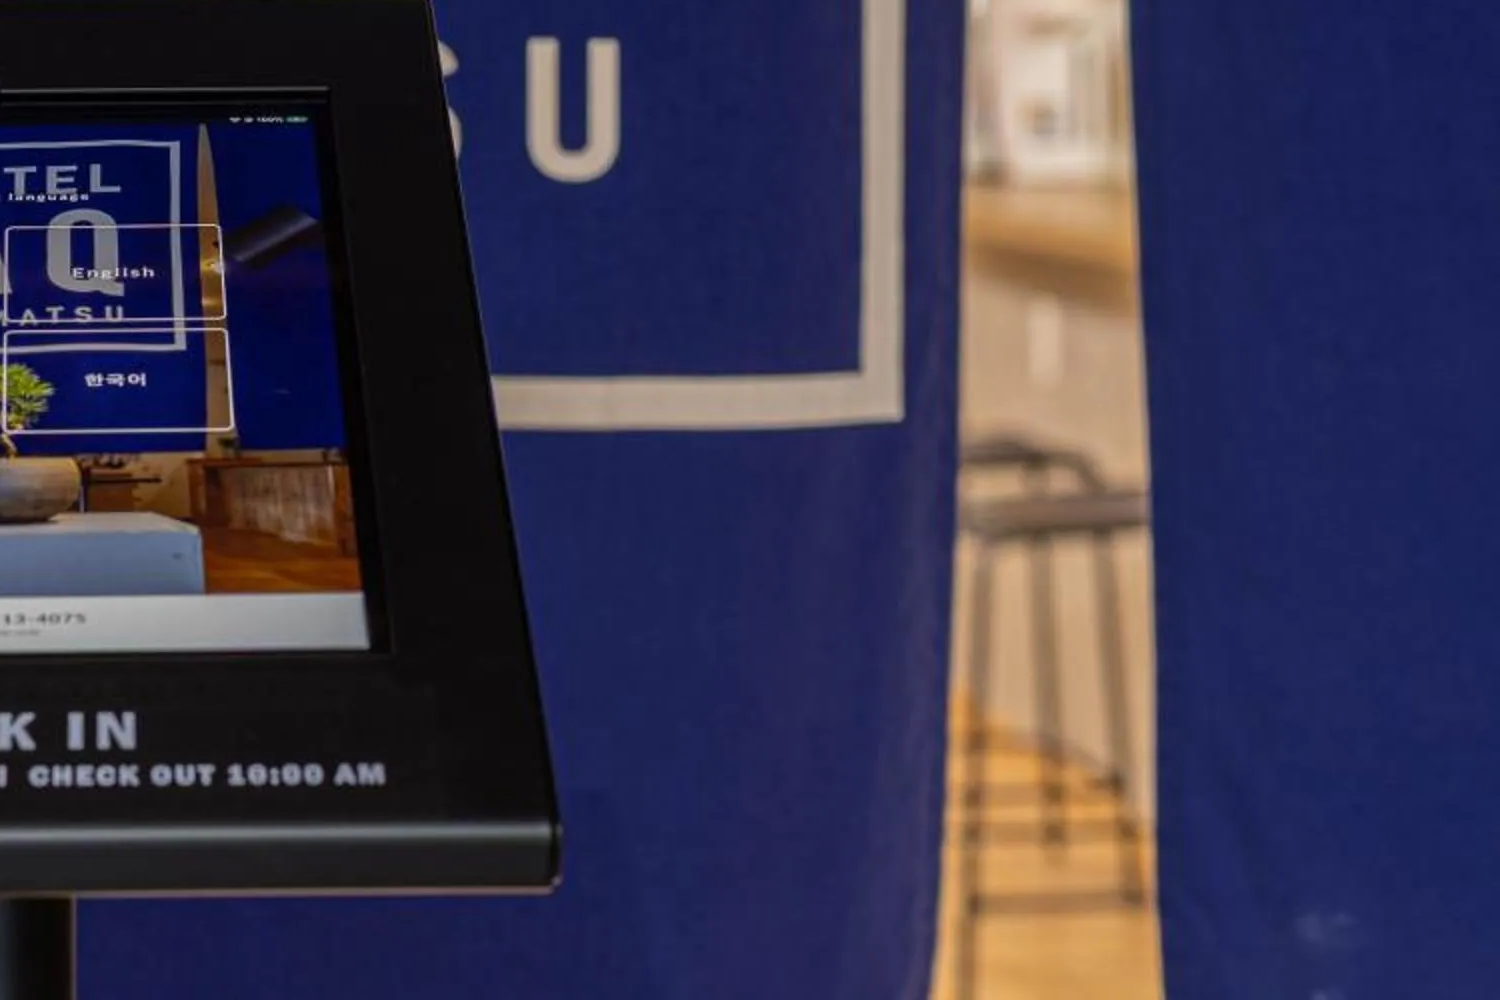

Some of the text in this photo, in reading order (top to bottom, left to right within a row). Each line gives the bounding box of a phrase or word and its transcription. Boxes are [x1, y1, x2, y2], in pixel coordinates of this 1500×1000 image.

[8, 190, 90, 203] language
[72, 266, 156, 280] English
[84, 372, 147, 388] 한국어
[67, 711, 138, 751] IN
[28, 764, 141, 788] CHECK
[149, 763, 217, 787] OUT
[227, 763, 325, 787] 10:00
[333, 762, 387, 786] AM
